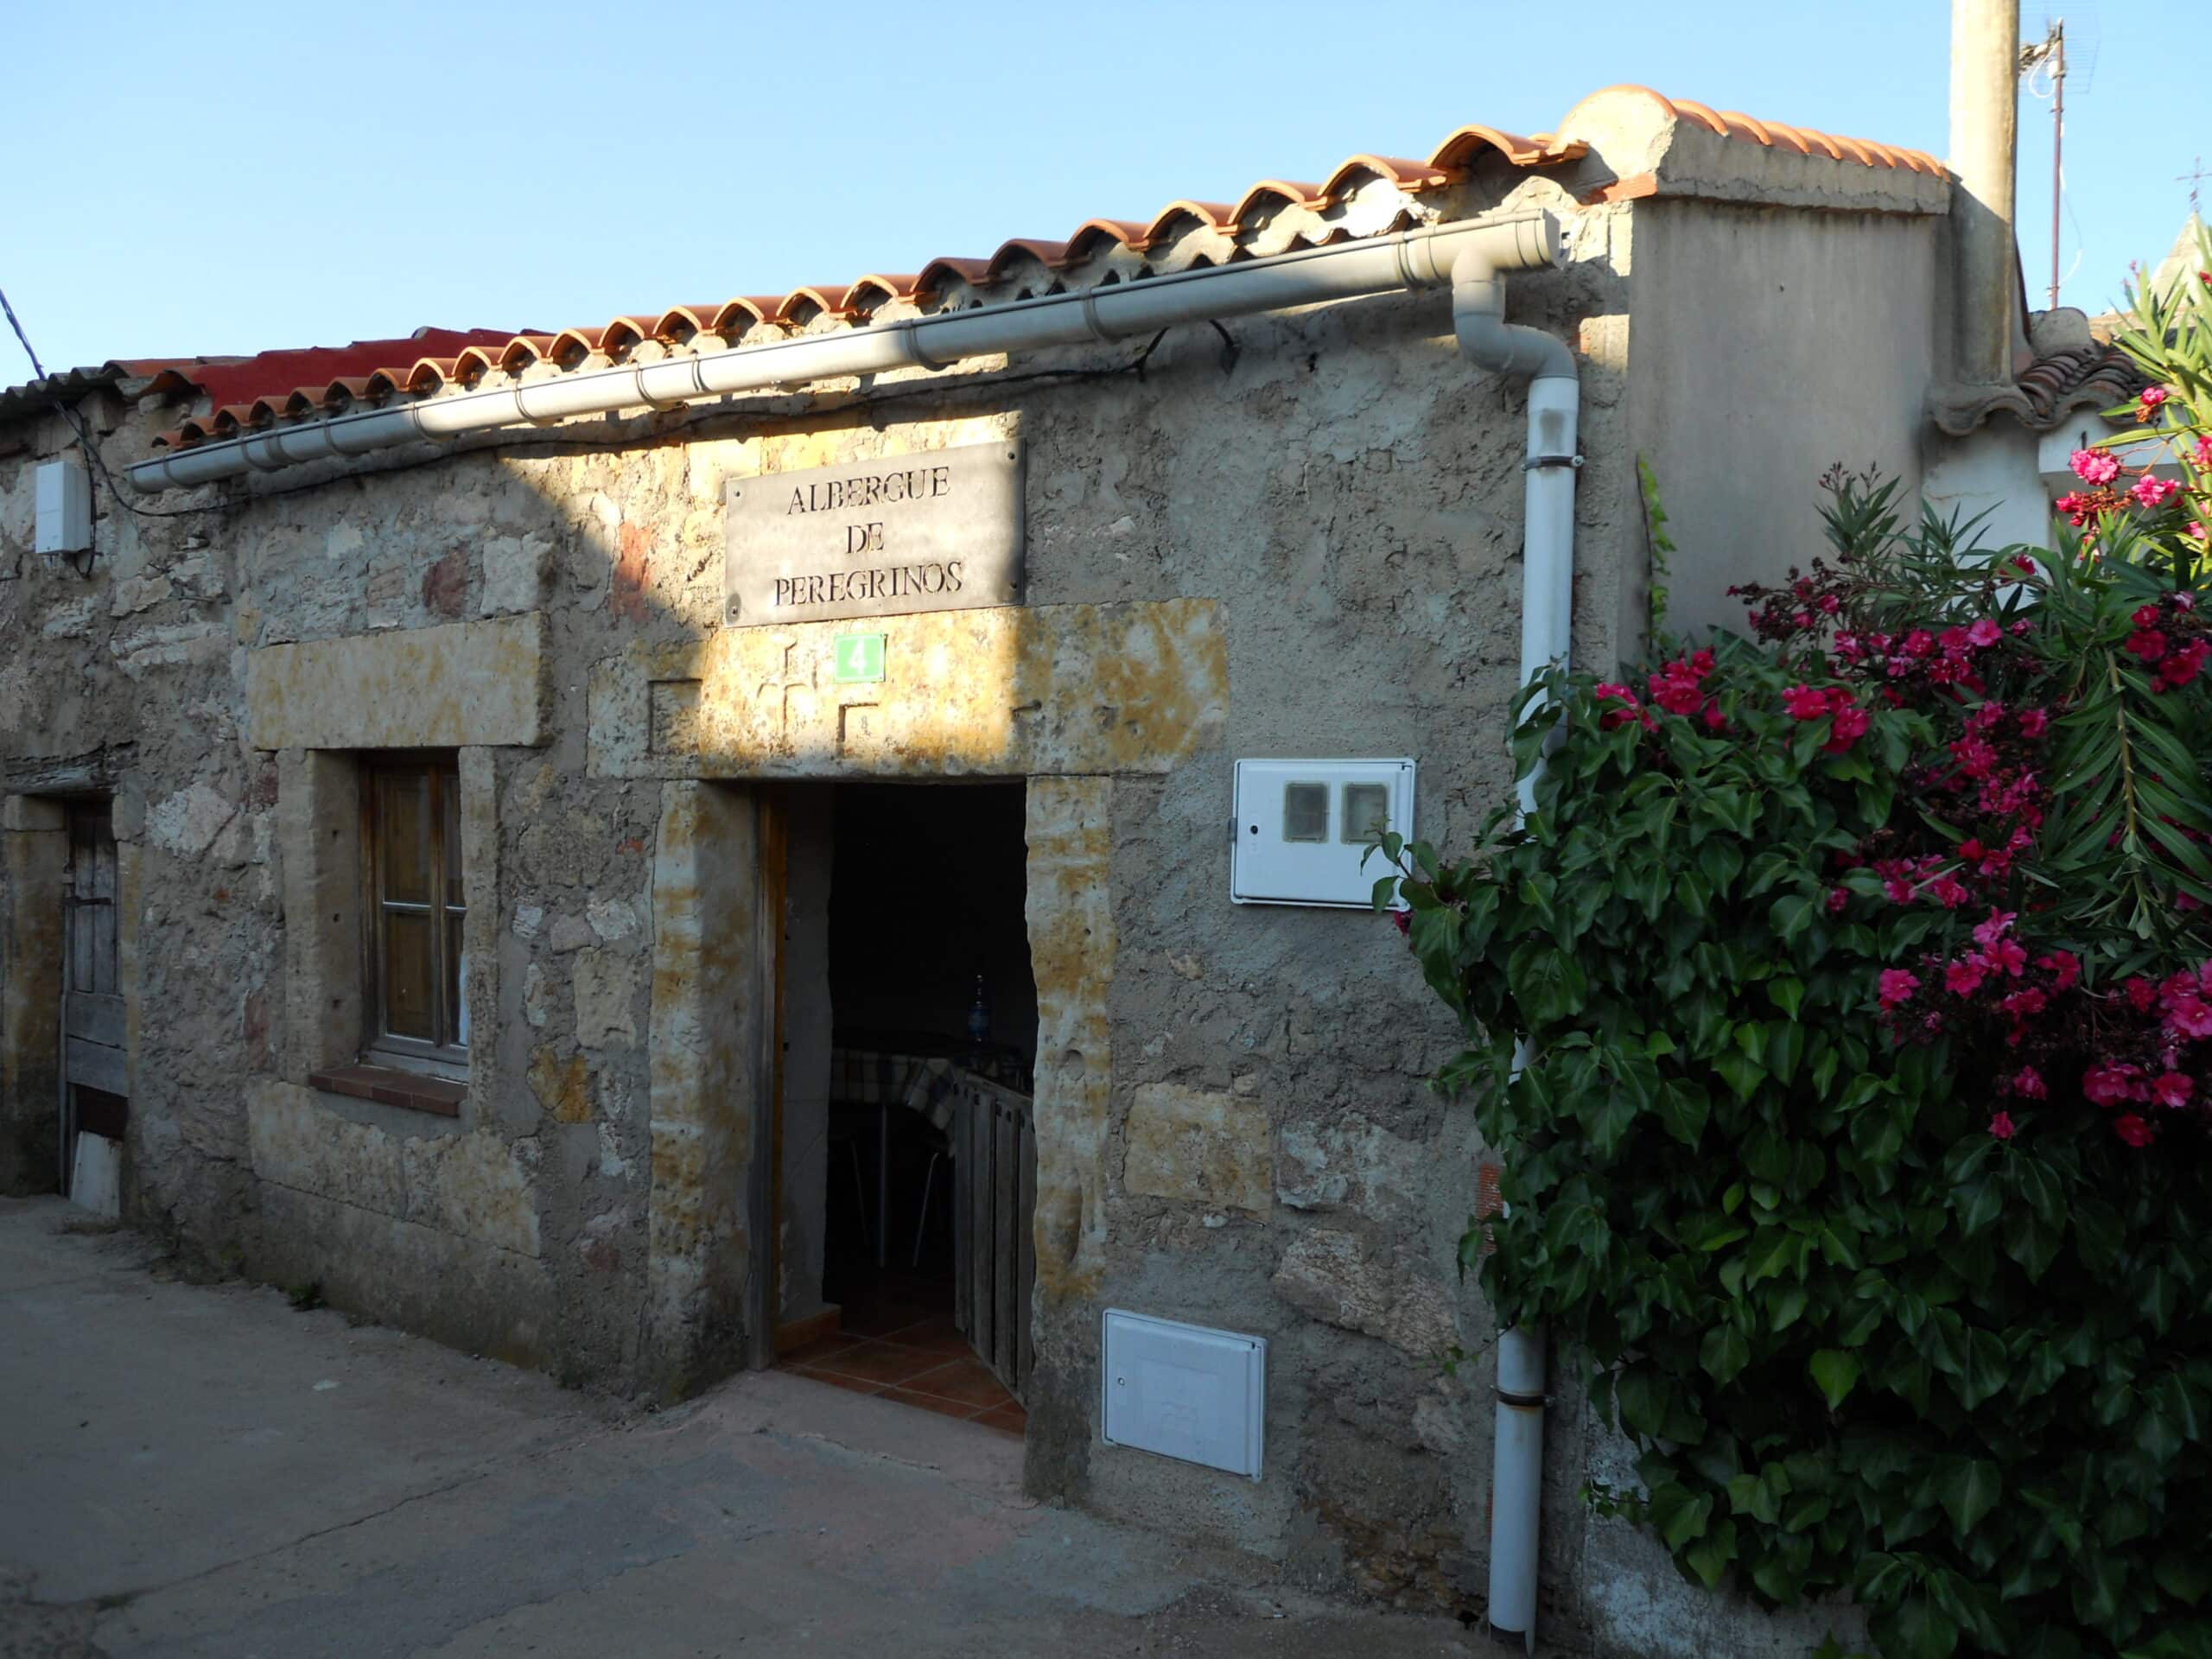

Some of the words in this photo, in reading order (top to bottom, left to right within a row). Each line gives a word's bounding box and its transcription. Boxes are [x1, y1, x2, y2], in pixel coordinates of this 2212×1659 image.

[787, 467, 951, 515] ALBERGUE
[846, 522, 885, 554] DE
[774, 561, 963, 607] PEREGRINOS
[848, 638, 866, 676] 4
